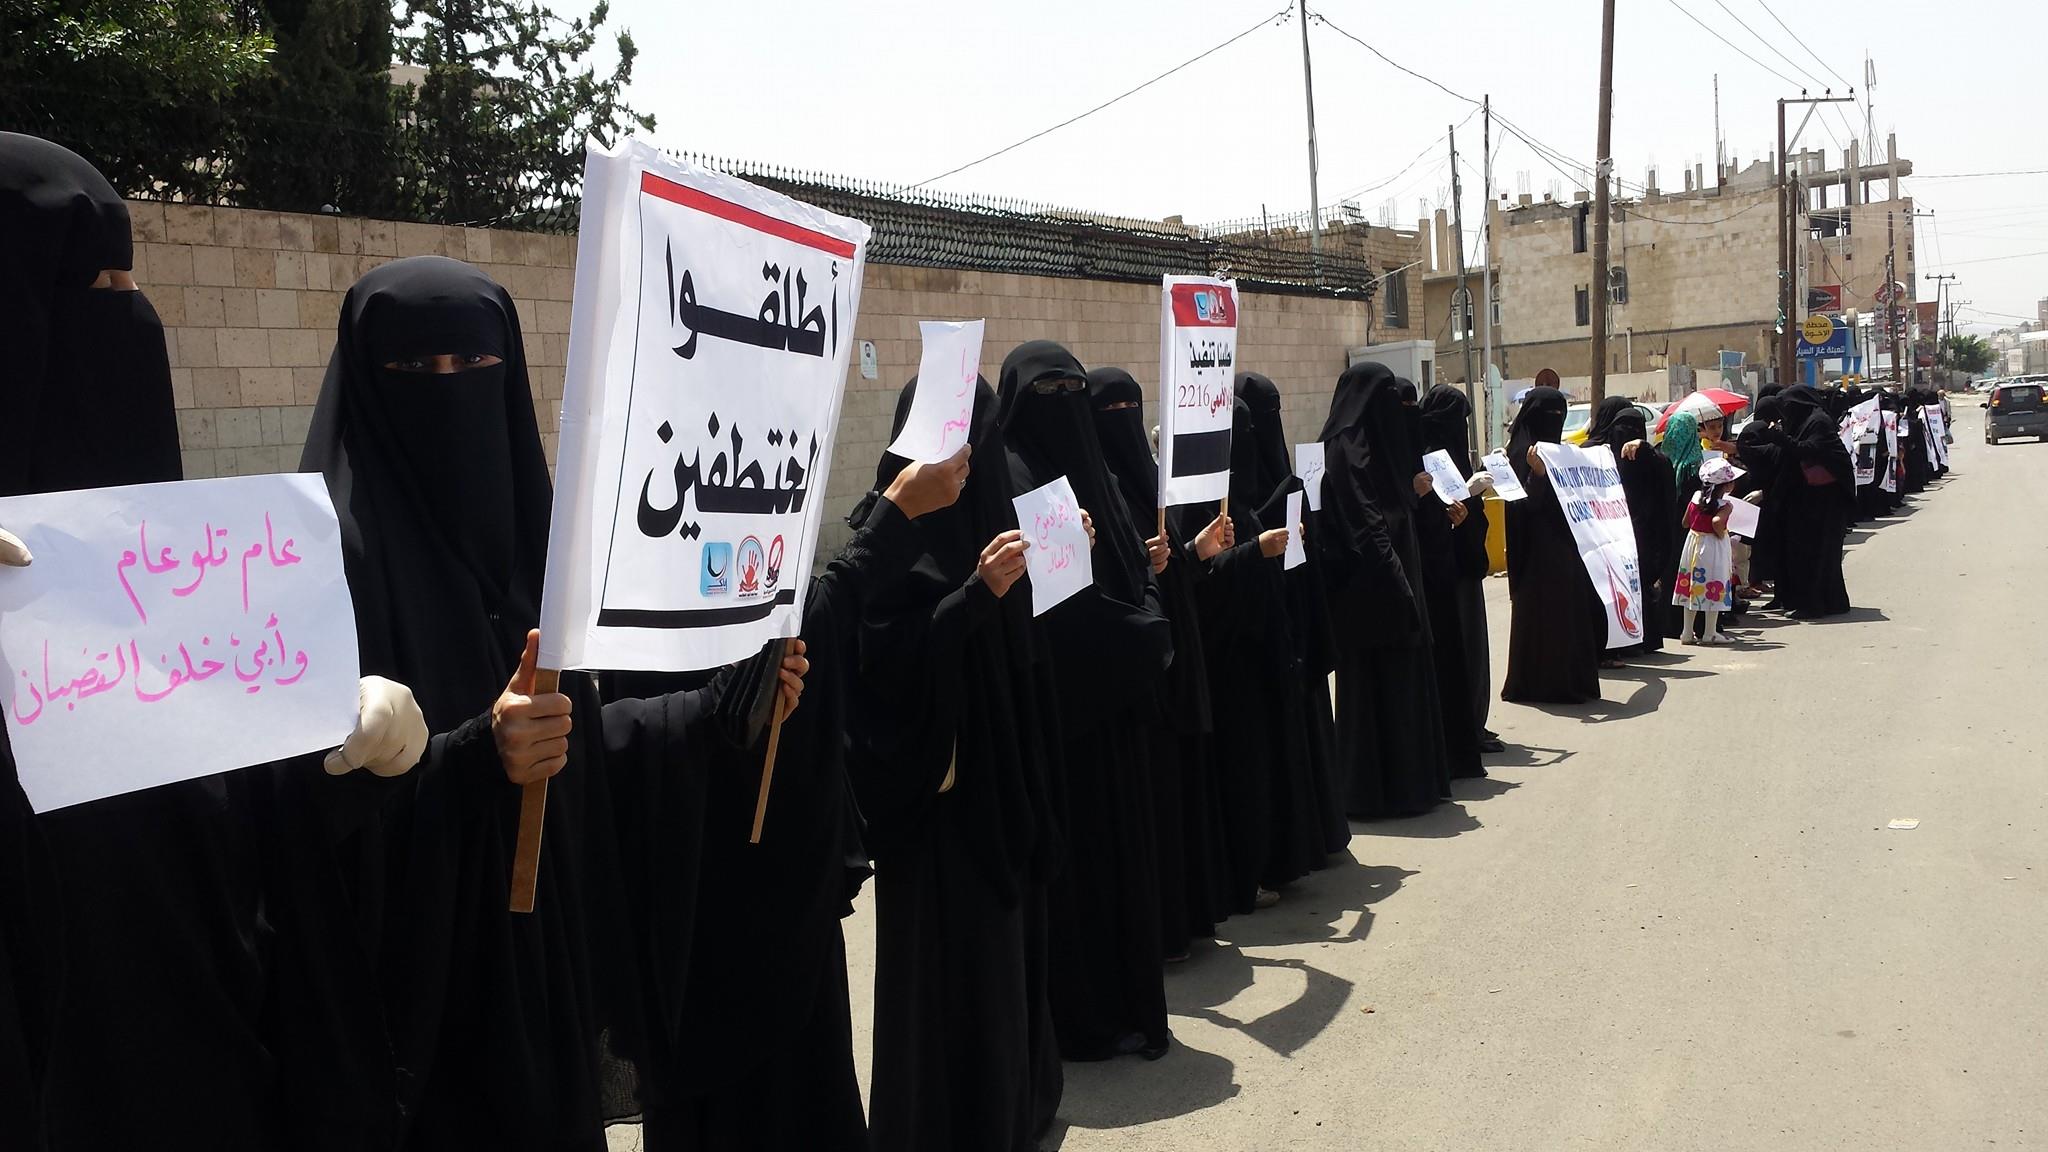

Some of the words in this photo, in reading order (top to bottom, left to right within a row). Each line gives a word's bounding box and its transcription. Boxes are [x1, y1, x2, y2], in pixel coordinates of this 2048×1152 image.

[666, 233, 839, 360] أطلقوا
[1178, 384, 1210, 408] 2216
[1190, 340, 1215, 376] تنفيذ
[117, 519, 180, 625] عام
[172, 523, 228, 597] تلو
[242, 511, 302, 614] عام
[13, 639, 141, 725] القضبان
[136, 635, 225, 702] خلف
